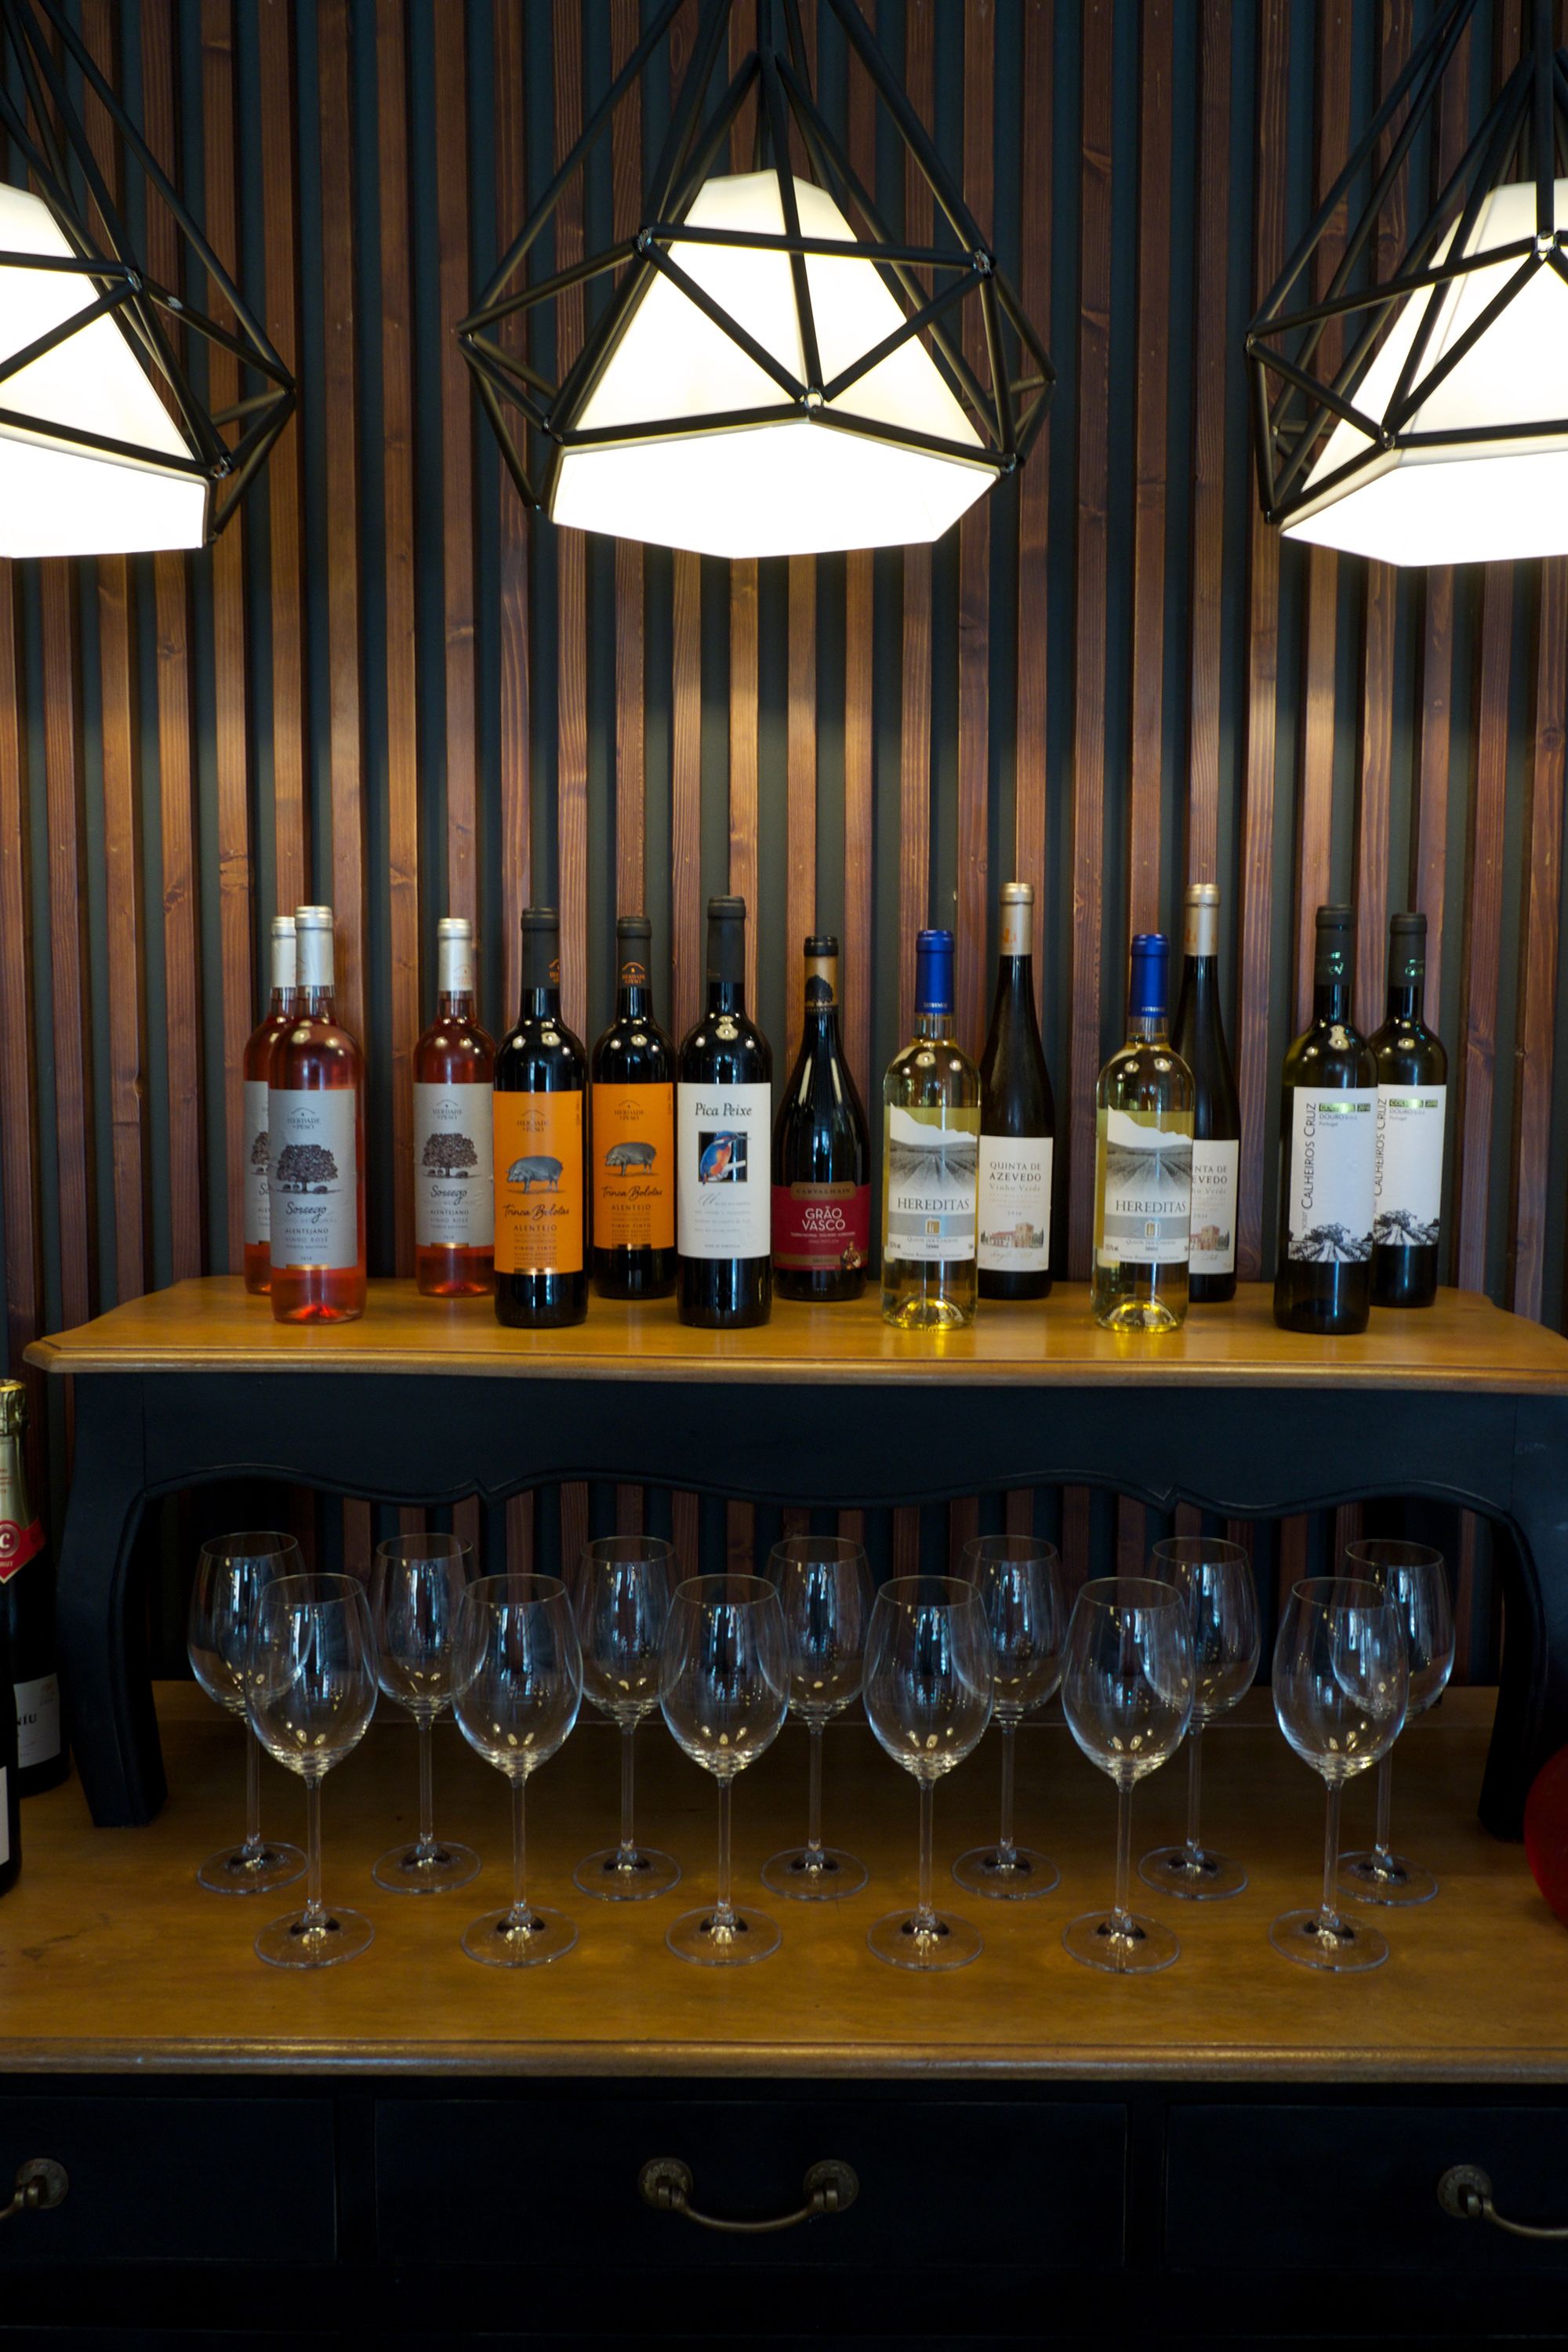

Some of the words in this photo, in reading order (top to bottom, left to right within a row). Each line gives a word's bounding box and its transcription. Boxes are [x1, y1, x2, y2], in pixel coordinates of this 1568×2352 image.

[695, 1102, 719, 1116] Pica
[723, 1102, 753, 1116] Peixe
[989, 1161, 1027, 1171] QUINTA
[1030, 1162, 1041, 1171] DE
[1217, 1165, 1228, 1174] DE
[989, 1172, 1041, 1181] AZEVEDO
[989, 1182, 1015, 1191] Vinho
[430, 1185, 468, 1206] Sossego
[898, 1198, 970, 1210] HEREDITAS
[1116, 1200, 1186, 1213] HEREDITAS
[285, 1200, 327, 1224] Sossego
[503, 1203, 530, 1218] Trinca
[532, 1203, 570, 1221] Bolotas
[805, 1206, 842, 1220] GRÃO
[801, 1218, 846, 1232] VASCO
